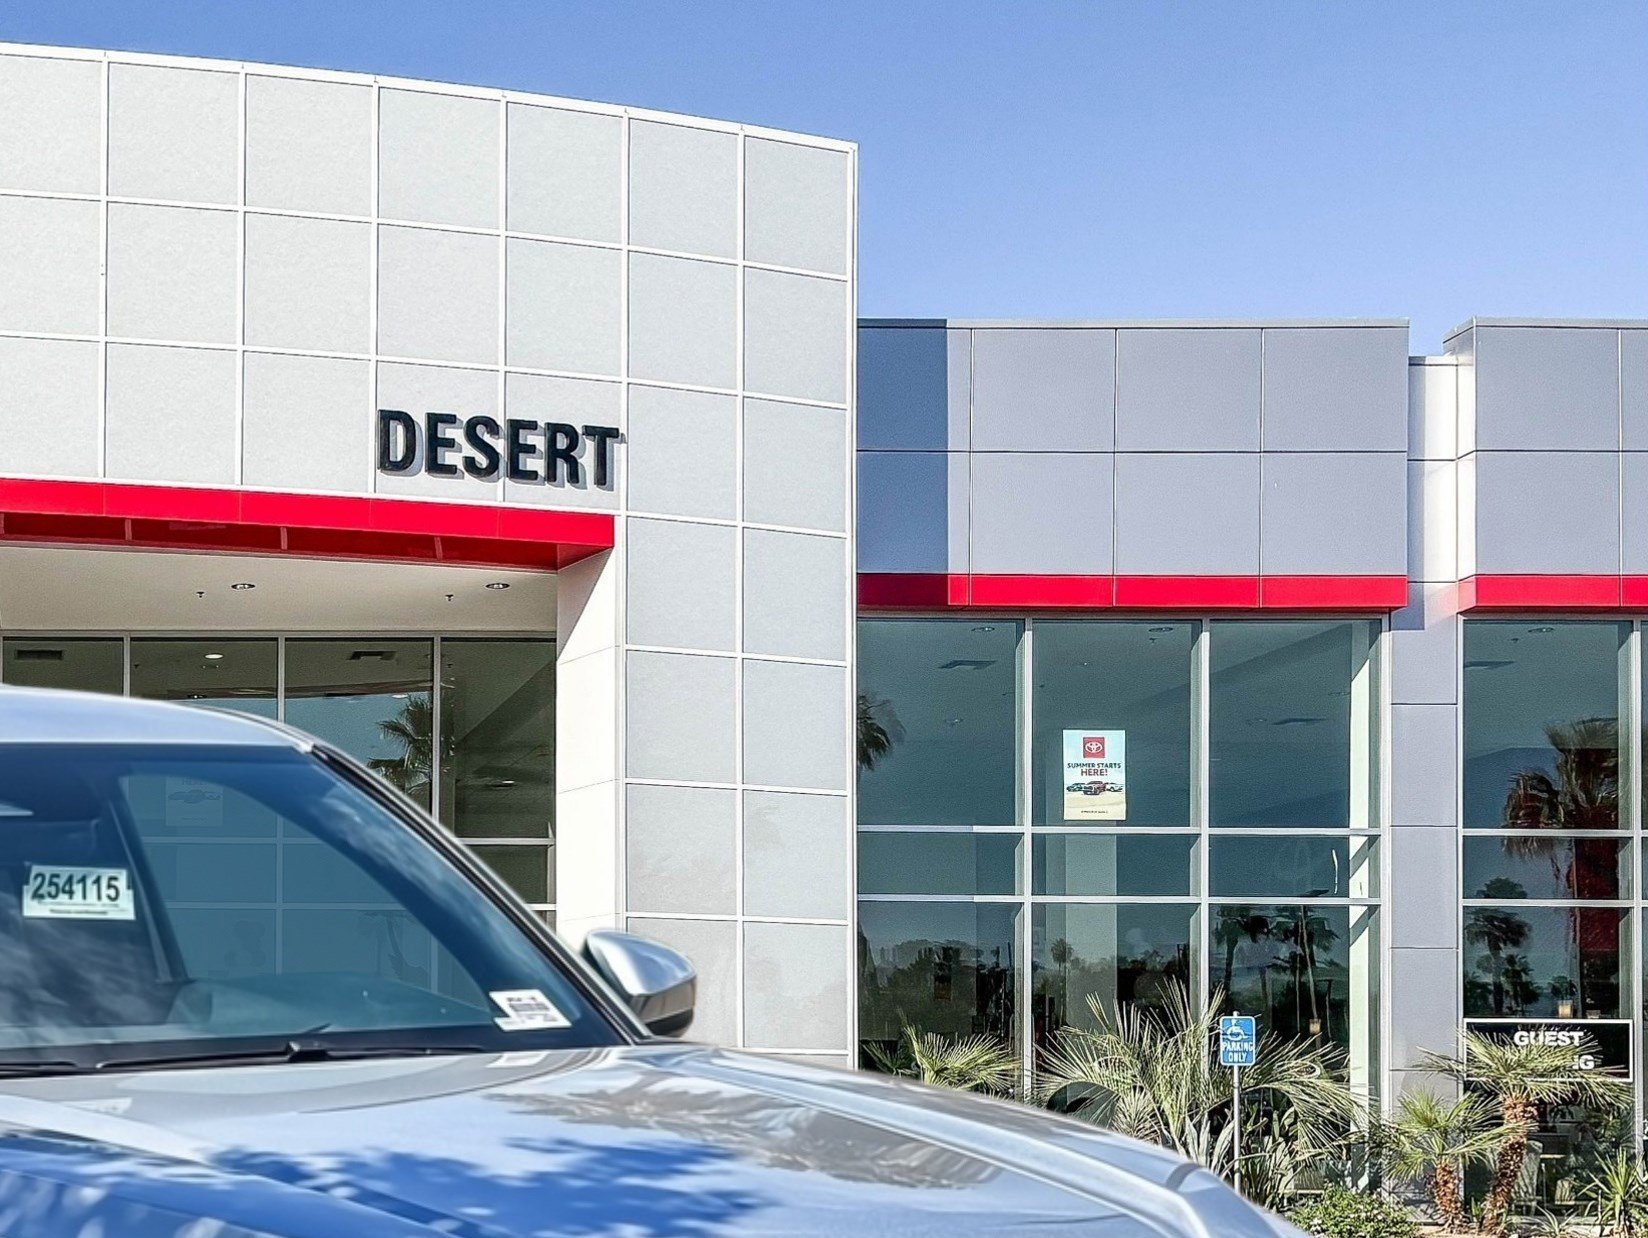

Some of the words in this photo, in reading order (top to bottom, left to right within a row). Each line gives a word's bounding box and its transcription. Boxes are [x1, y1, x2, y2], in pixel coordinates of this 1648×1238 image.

[377, 409, 620, 487] DESERT
[1080, 768, 1108, 776] HERE!
[31, 872, 121, 902] 254115
[1513, 1030, 1584, 1047] GUEST
[1222, 1041, 1253, 1052] PARKING
[1228, 1052, 1247, 1062] ONLY
